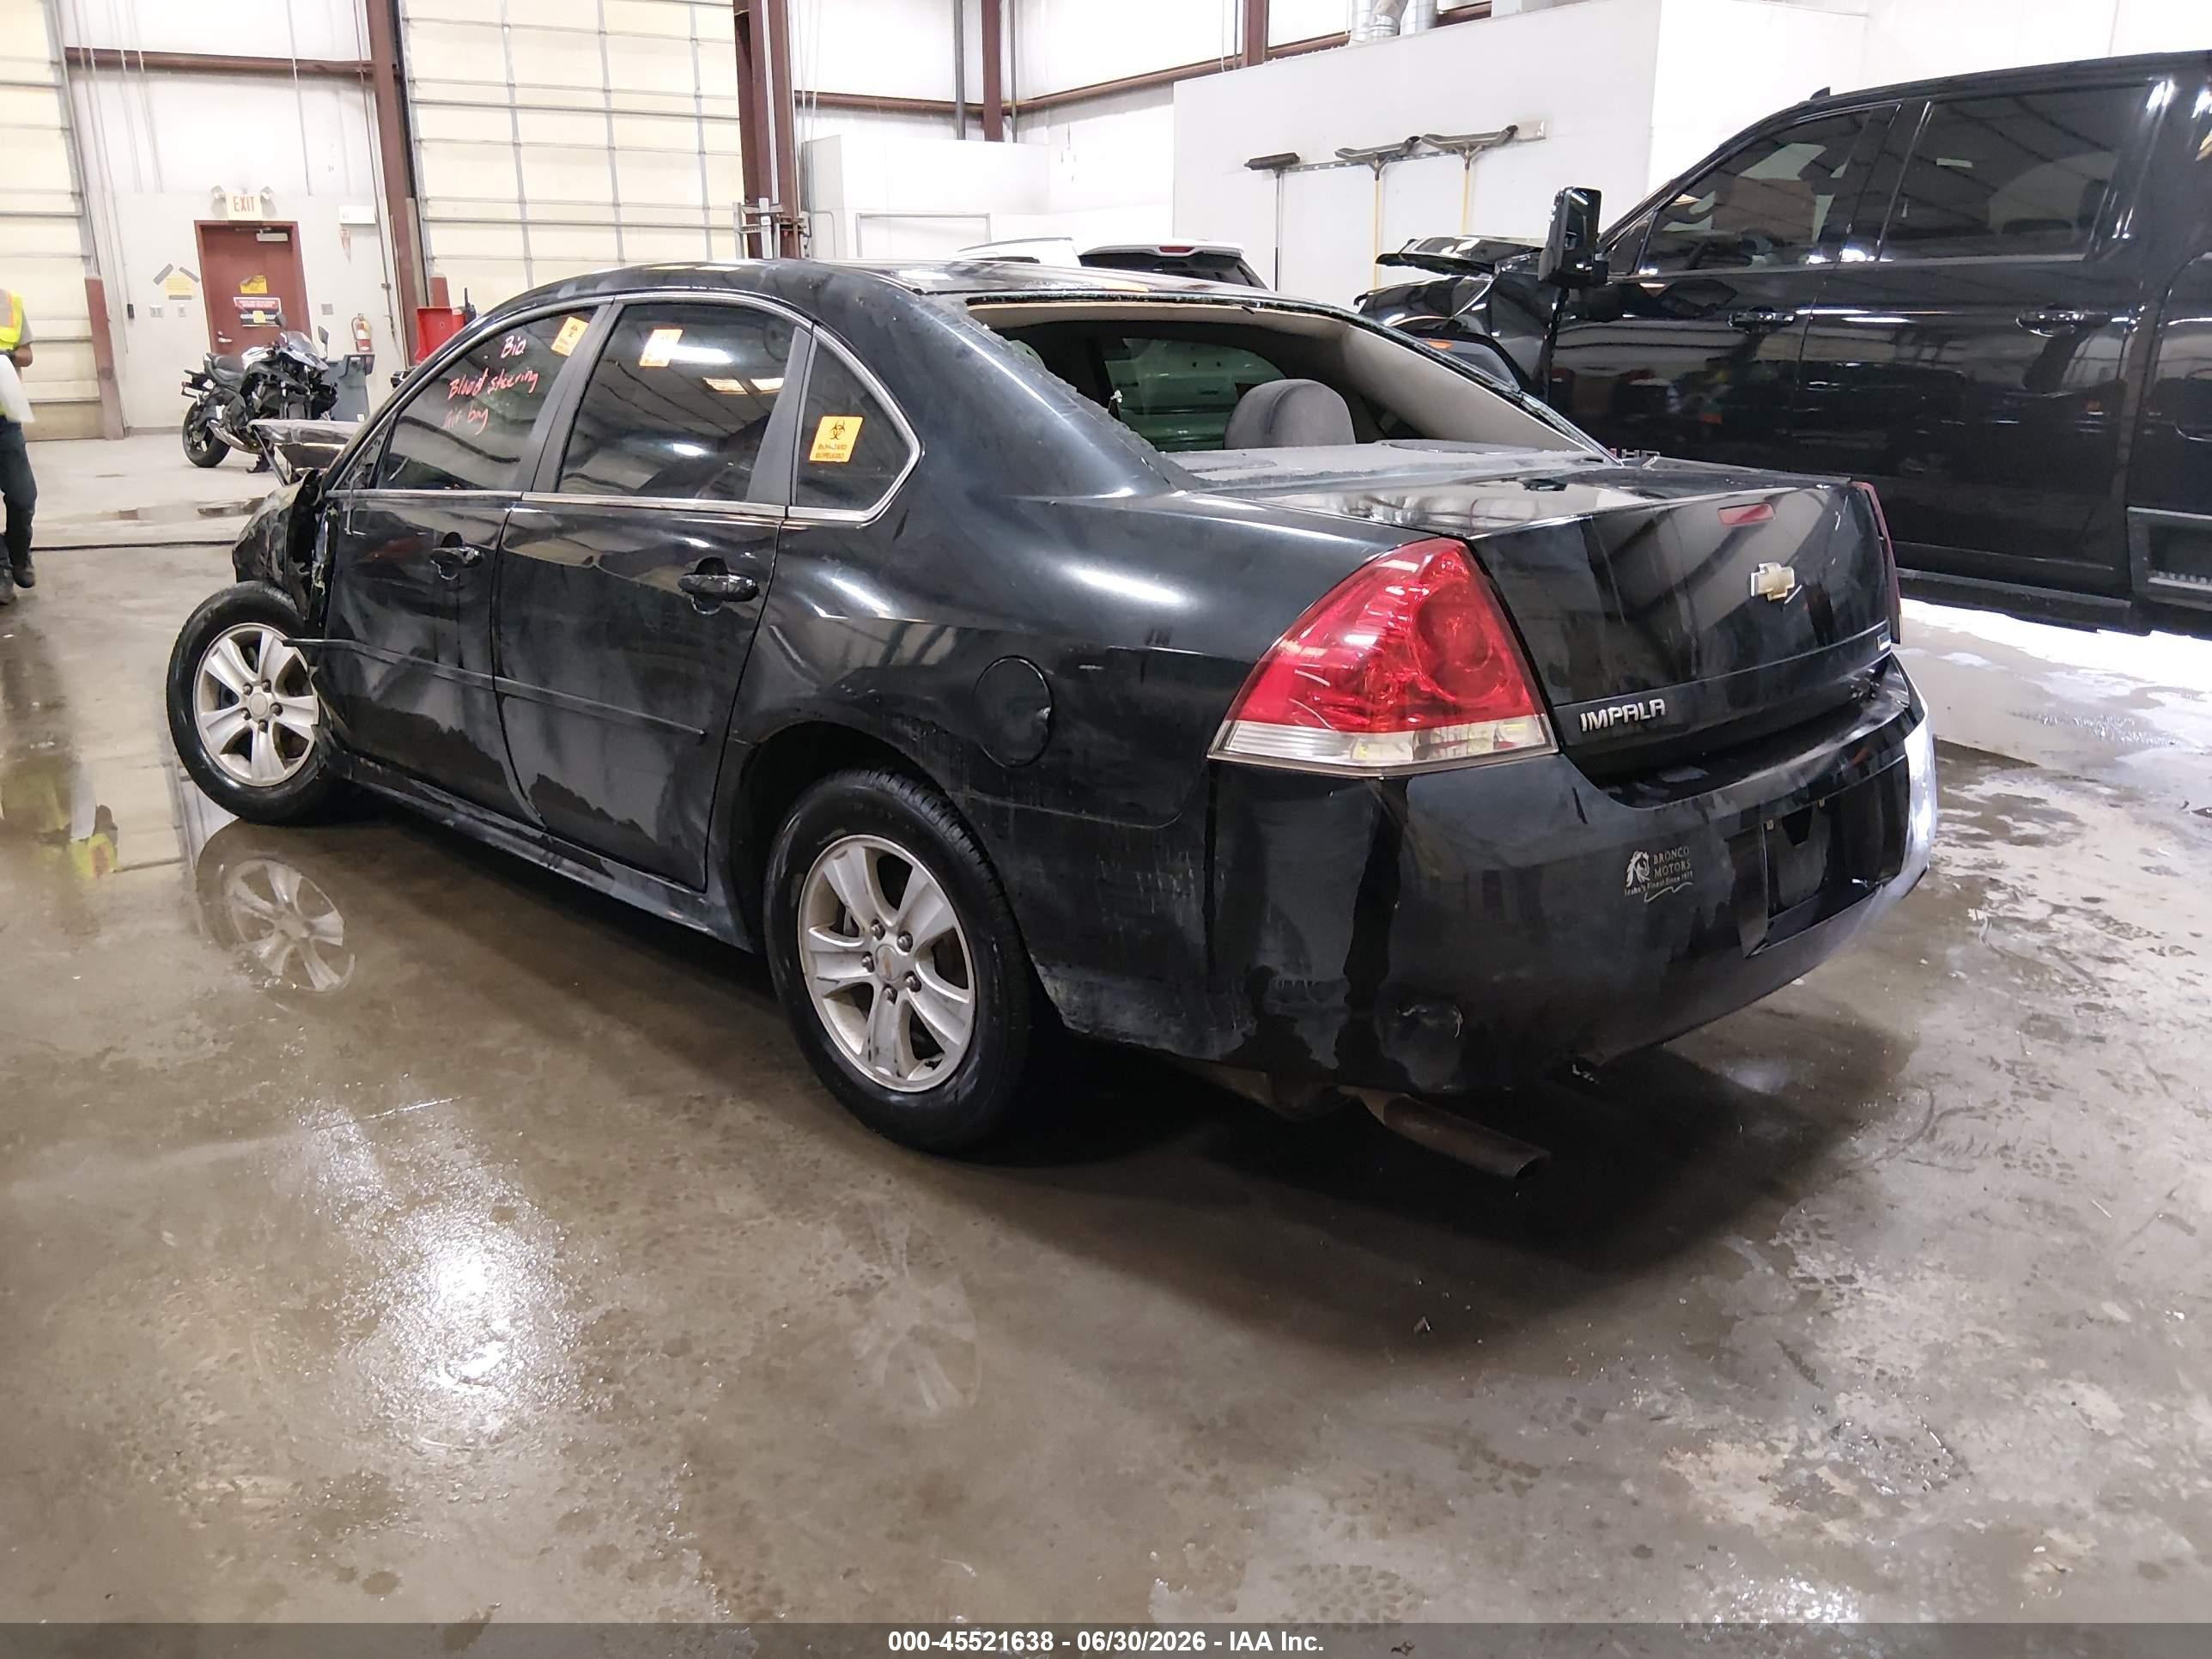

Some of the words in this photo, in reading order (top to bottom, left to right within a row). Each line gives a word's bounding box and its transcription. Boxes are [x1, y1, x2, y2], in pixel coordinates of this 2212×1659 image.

[233, 196, 255, 212] EXIT
[447, 368, 489, 399] Blood
[1579, 698, 1666, 732] IMPALA
[1653, 845, 1690, 865] BRONCO
[1654, 859, 1691, 878] MOTORS
